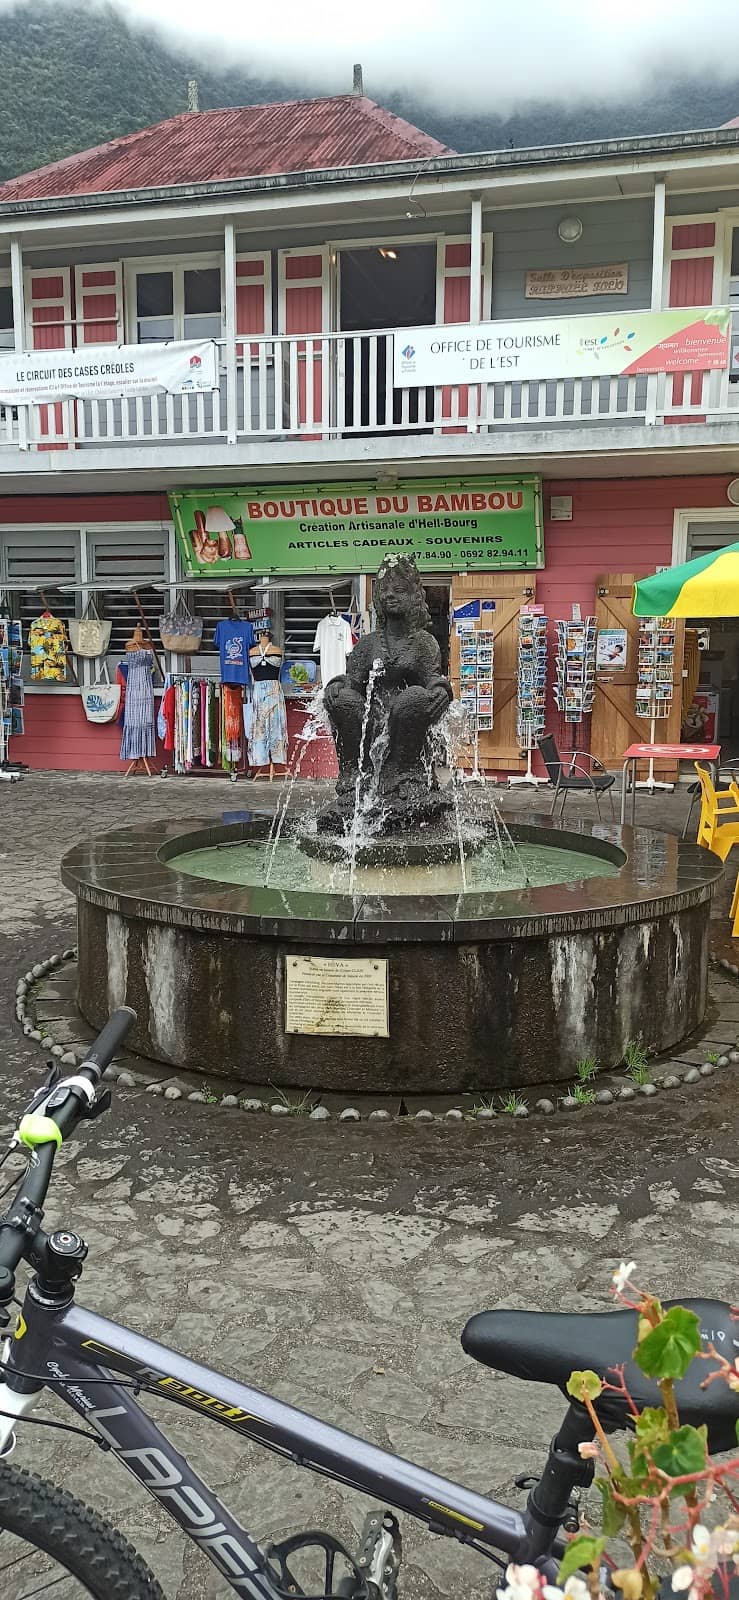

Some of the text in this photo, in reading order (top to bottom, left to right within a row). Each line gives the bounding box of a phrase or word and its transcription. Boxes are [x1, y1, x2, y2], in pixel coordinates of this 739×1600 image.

[430, 334, 561, 354] OFFICE DE TOURISME
[685, 336, 727, 346] bienvenue
[469, 355, 520, 370] DE L'EST
[665, 357, 700, 366] welcome
[16, 371, 25, 382] LE
[26, 369, 56, 381] CIRCUIT
[58, 367, 73, 379] DES
[74, 365, 99, 377] CASES
[247, 491, 524, 519] BOUTIQUE DU BAMBOU
[299, 518, 478, 533] Création Artisanale d'Hell-Bourg
[288, 540, 349, 549] ARTICLES
[352, 538, 414, 547] CADEAUX
[425, 535, 503, 545] SOUVENIRS
[460, 550, 484, 558] 0692
[487, 549, 528, 558] 82.94.11
